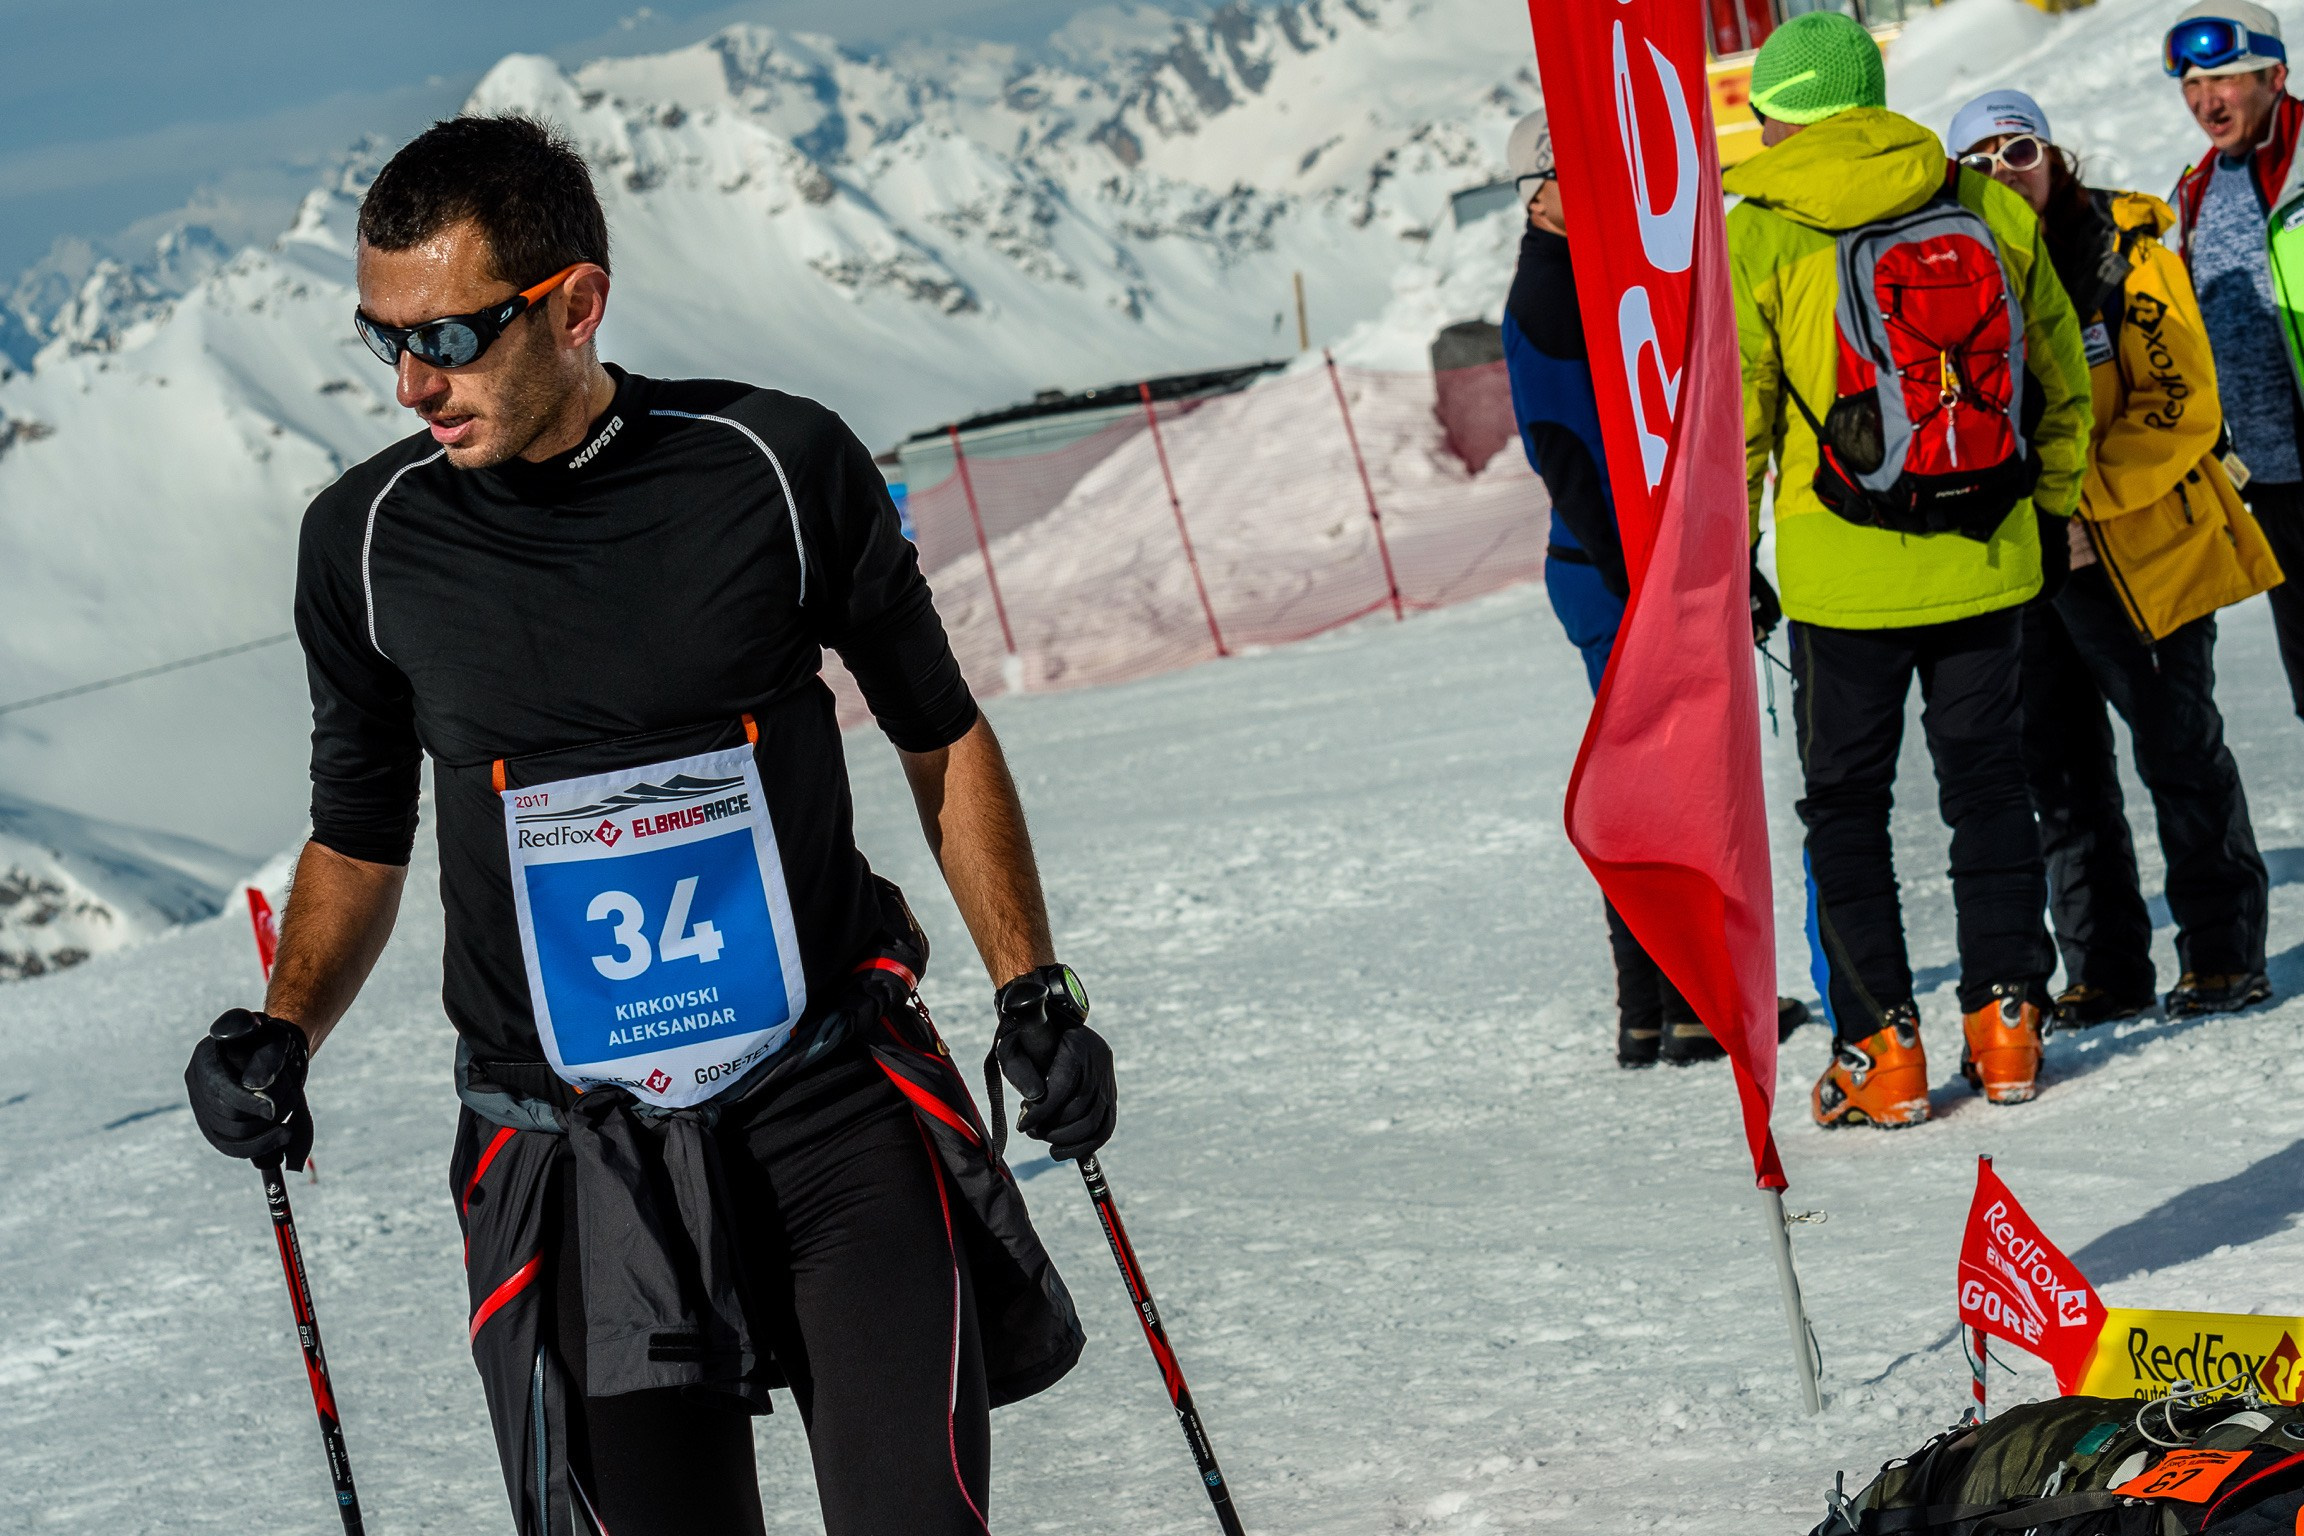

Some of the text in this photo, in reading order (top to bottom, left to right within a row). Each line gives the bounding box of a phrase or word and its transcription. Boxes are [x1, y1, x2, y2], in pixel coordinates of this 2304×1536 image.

[571, 415, 624, 469] KIPSTA
[514, 793, 549, 809] 2017
[631, 793, 752, 839] ELBRUSRACE
[518, 826, 596, 849] RedFox
[586, 875, 725, 981] 34
[615, 986, 720, 1021] KIRKOVSKI
[608, 1007, 737, 1046] ALEKSANDAR
[1983, 1200, 2067, 1303] RedFox
[2127, 1327, 2267, 1396] RedFox
[2143, 1468, 2205, 1494] 67
